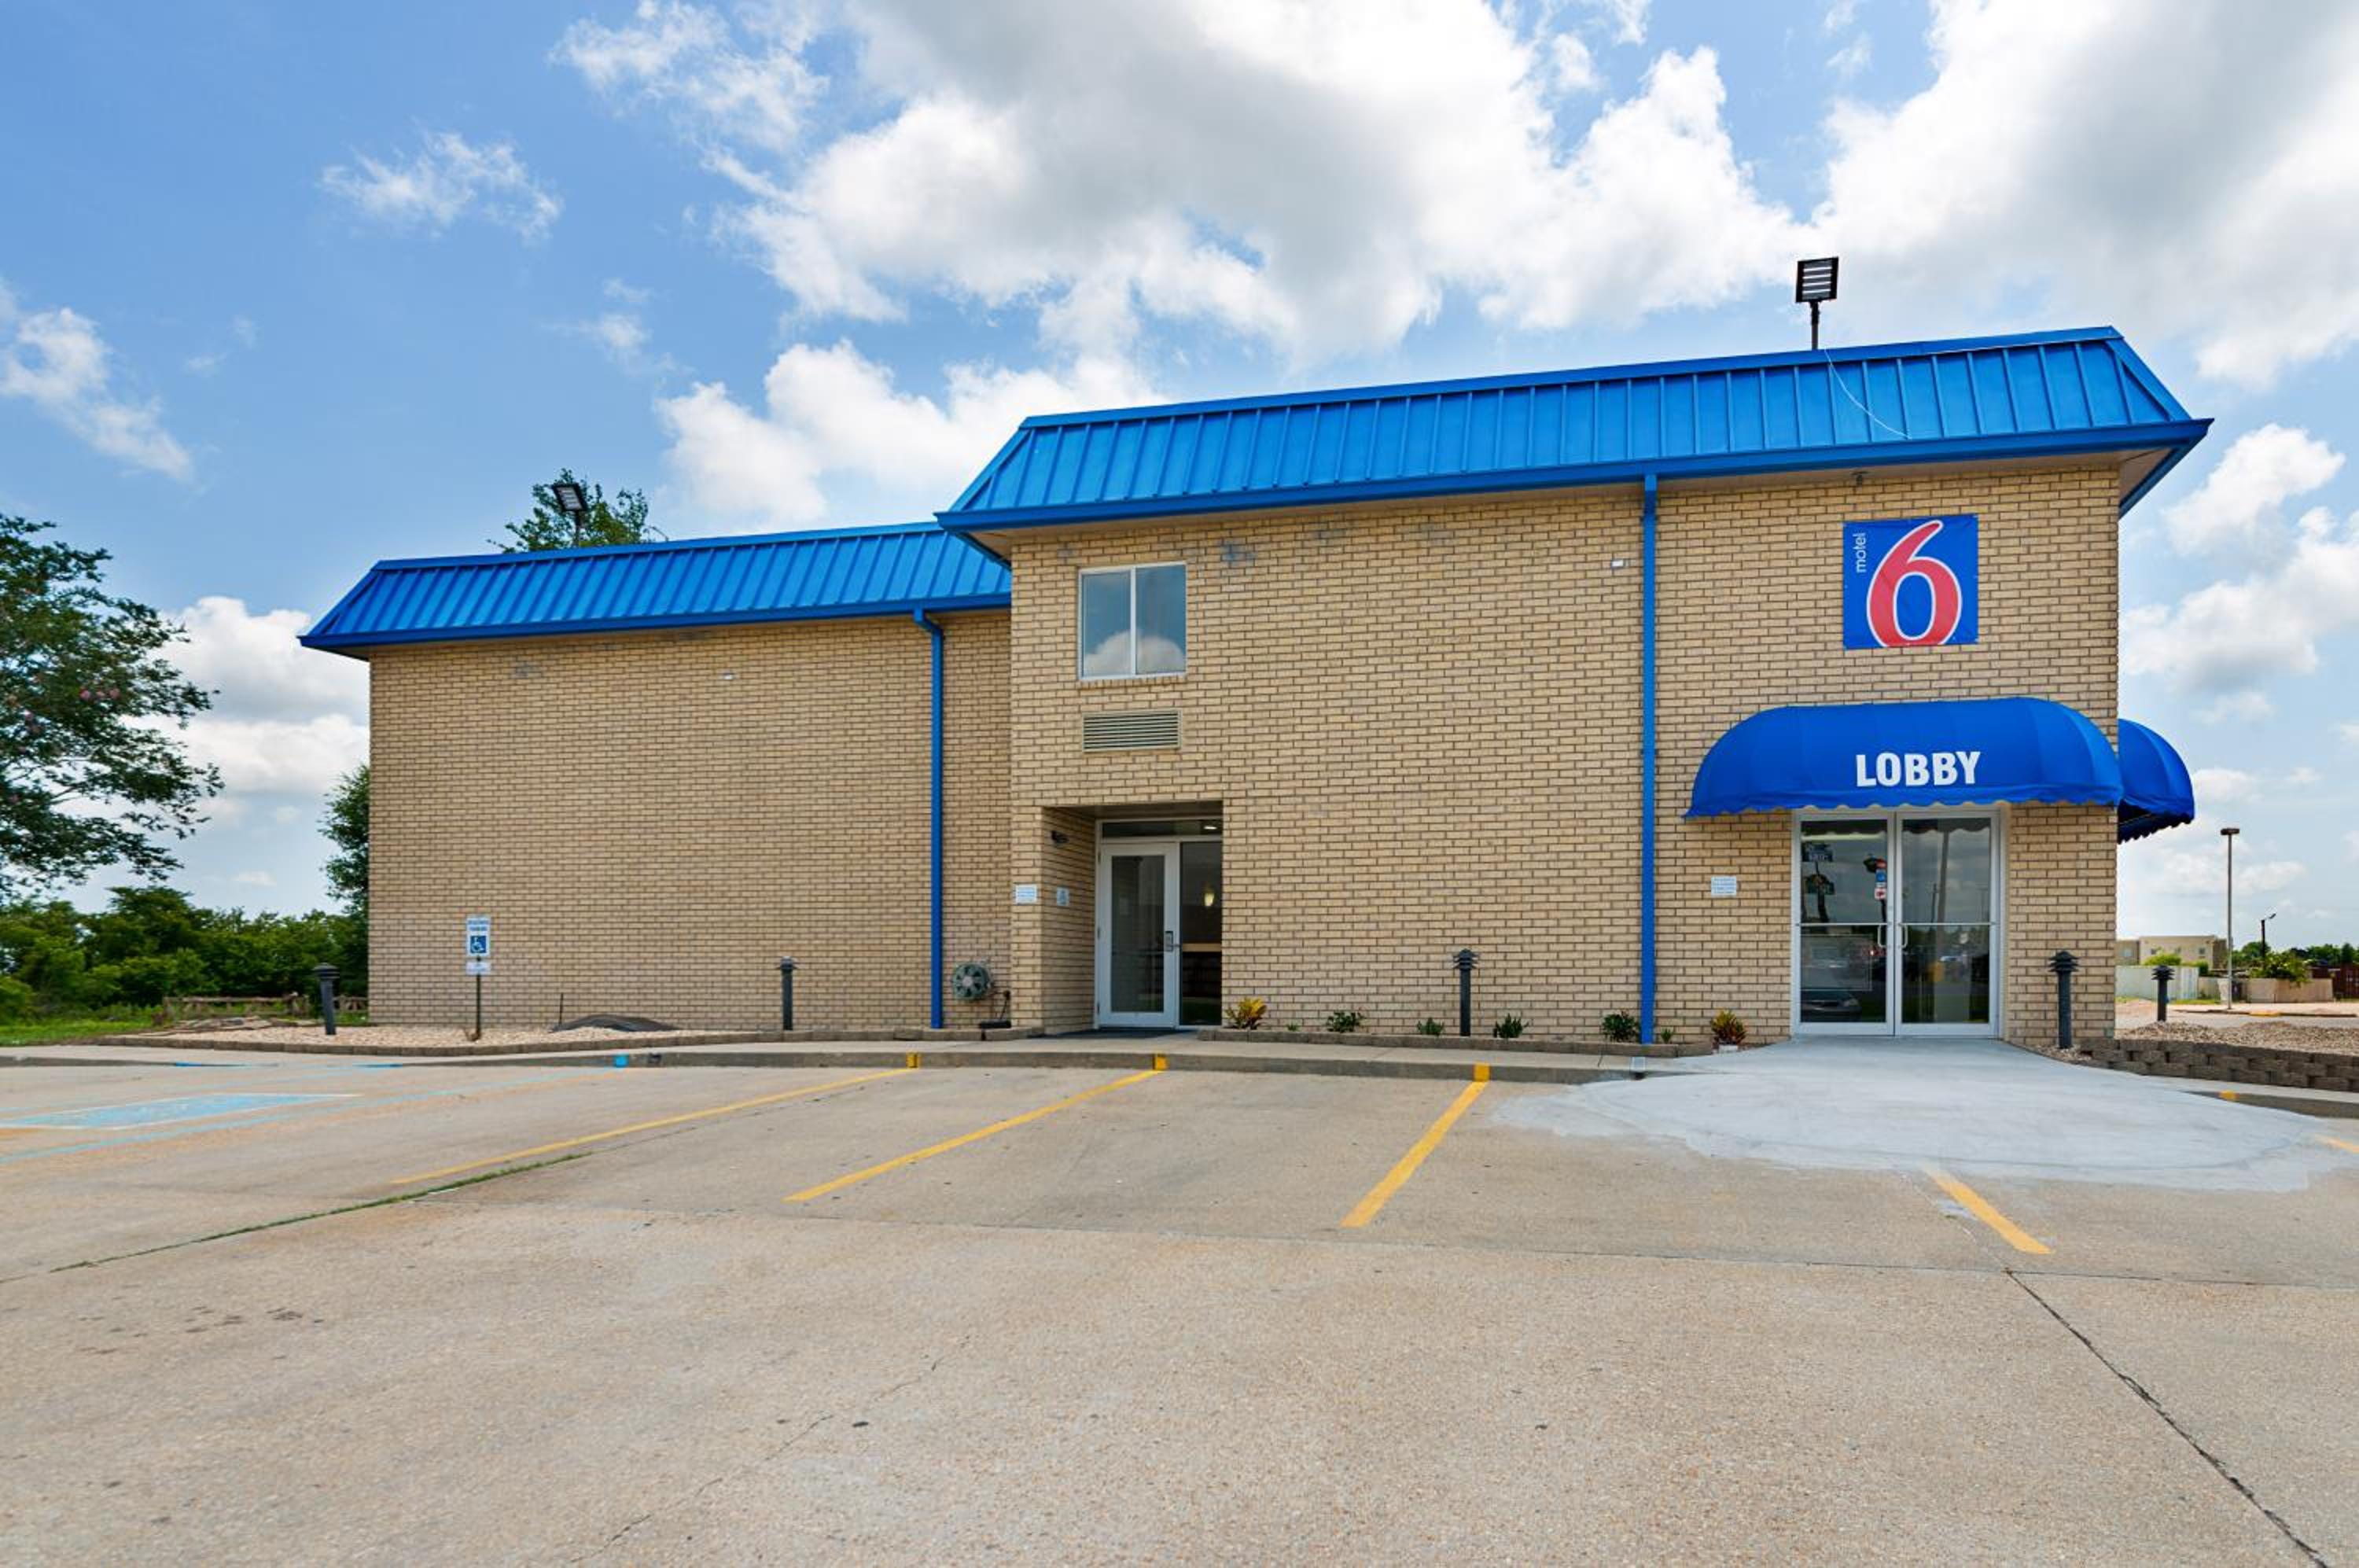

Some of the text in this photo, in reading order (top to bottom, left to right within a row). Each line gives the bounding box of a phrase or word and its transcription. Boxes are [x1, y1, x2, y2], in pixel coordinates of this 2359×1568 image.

[1853, 532, 1867, 573] motel
[1867, 520, 1962, 646] 6
[1856, 751, 1981, 786] LOBBY
